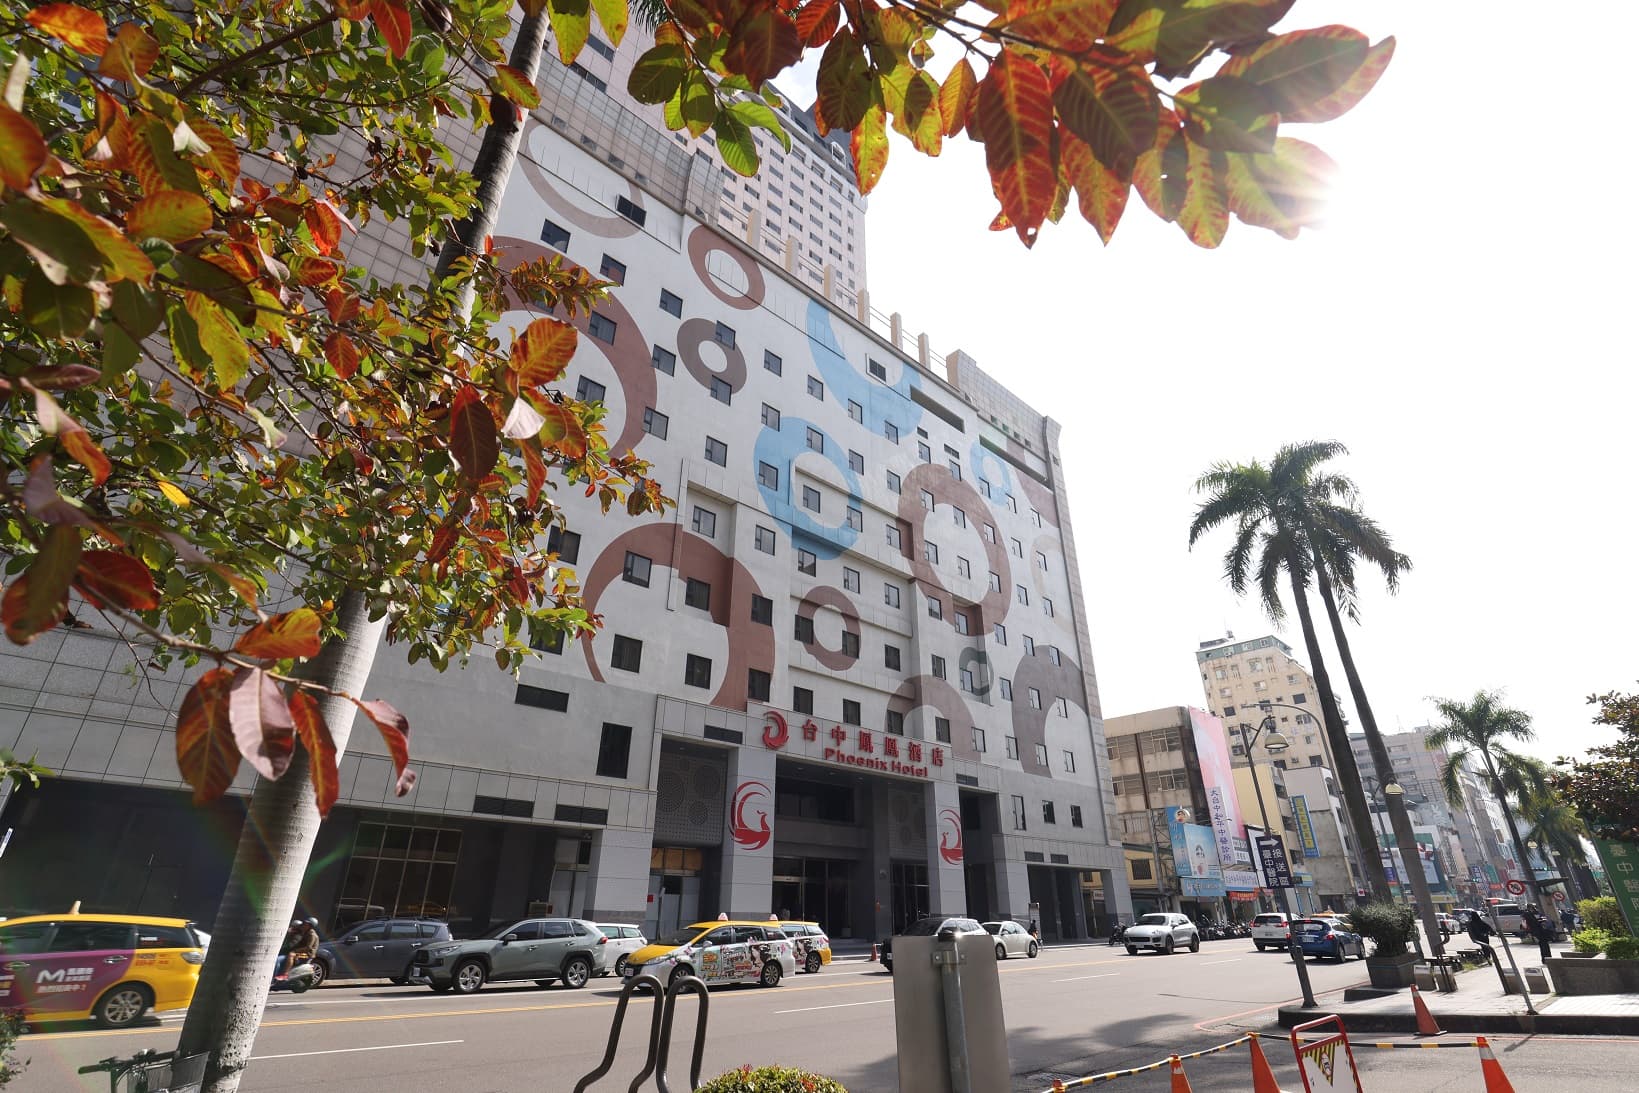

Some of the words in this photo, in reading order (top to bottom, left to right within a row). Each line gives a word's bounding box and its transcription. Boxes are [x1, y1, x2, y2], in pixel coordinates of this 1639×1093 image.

[802, 719, 944, 767] 台中鳳凰酒店
[824, 747, 888, 771] Phoenix
[891, 761, 929, 778] Hotel
